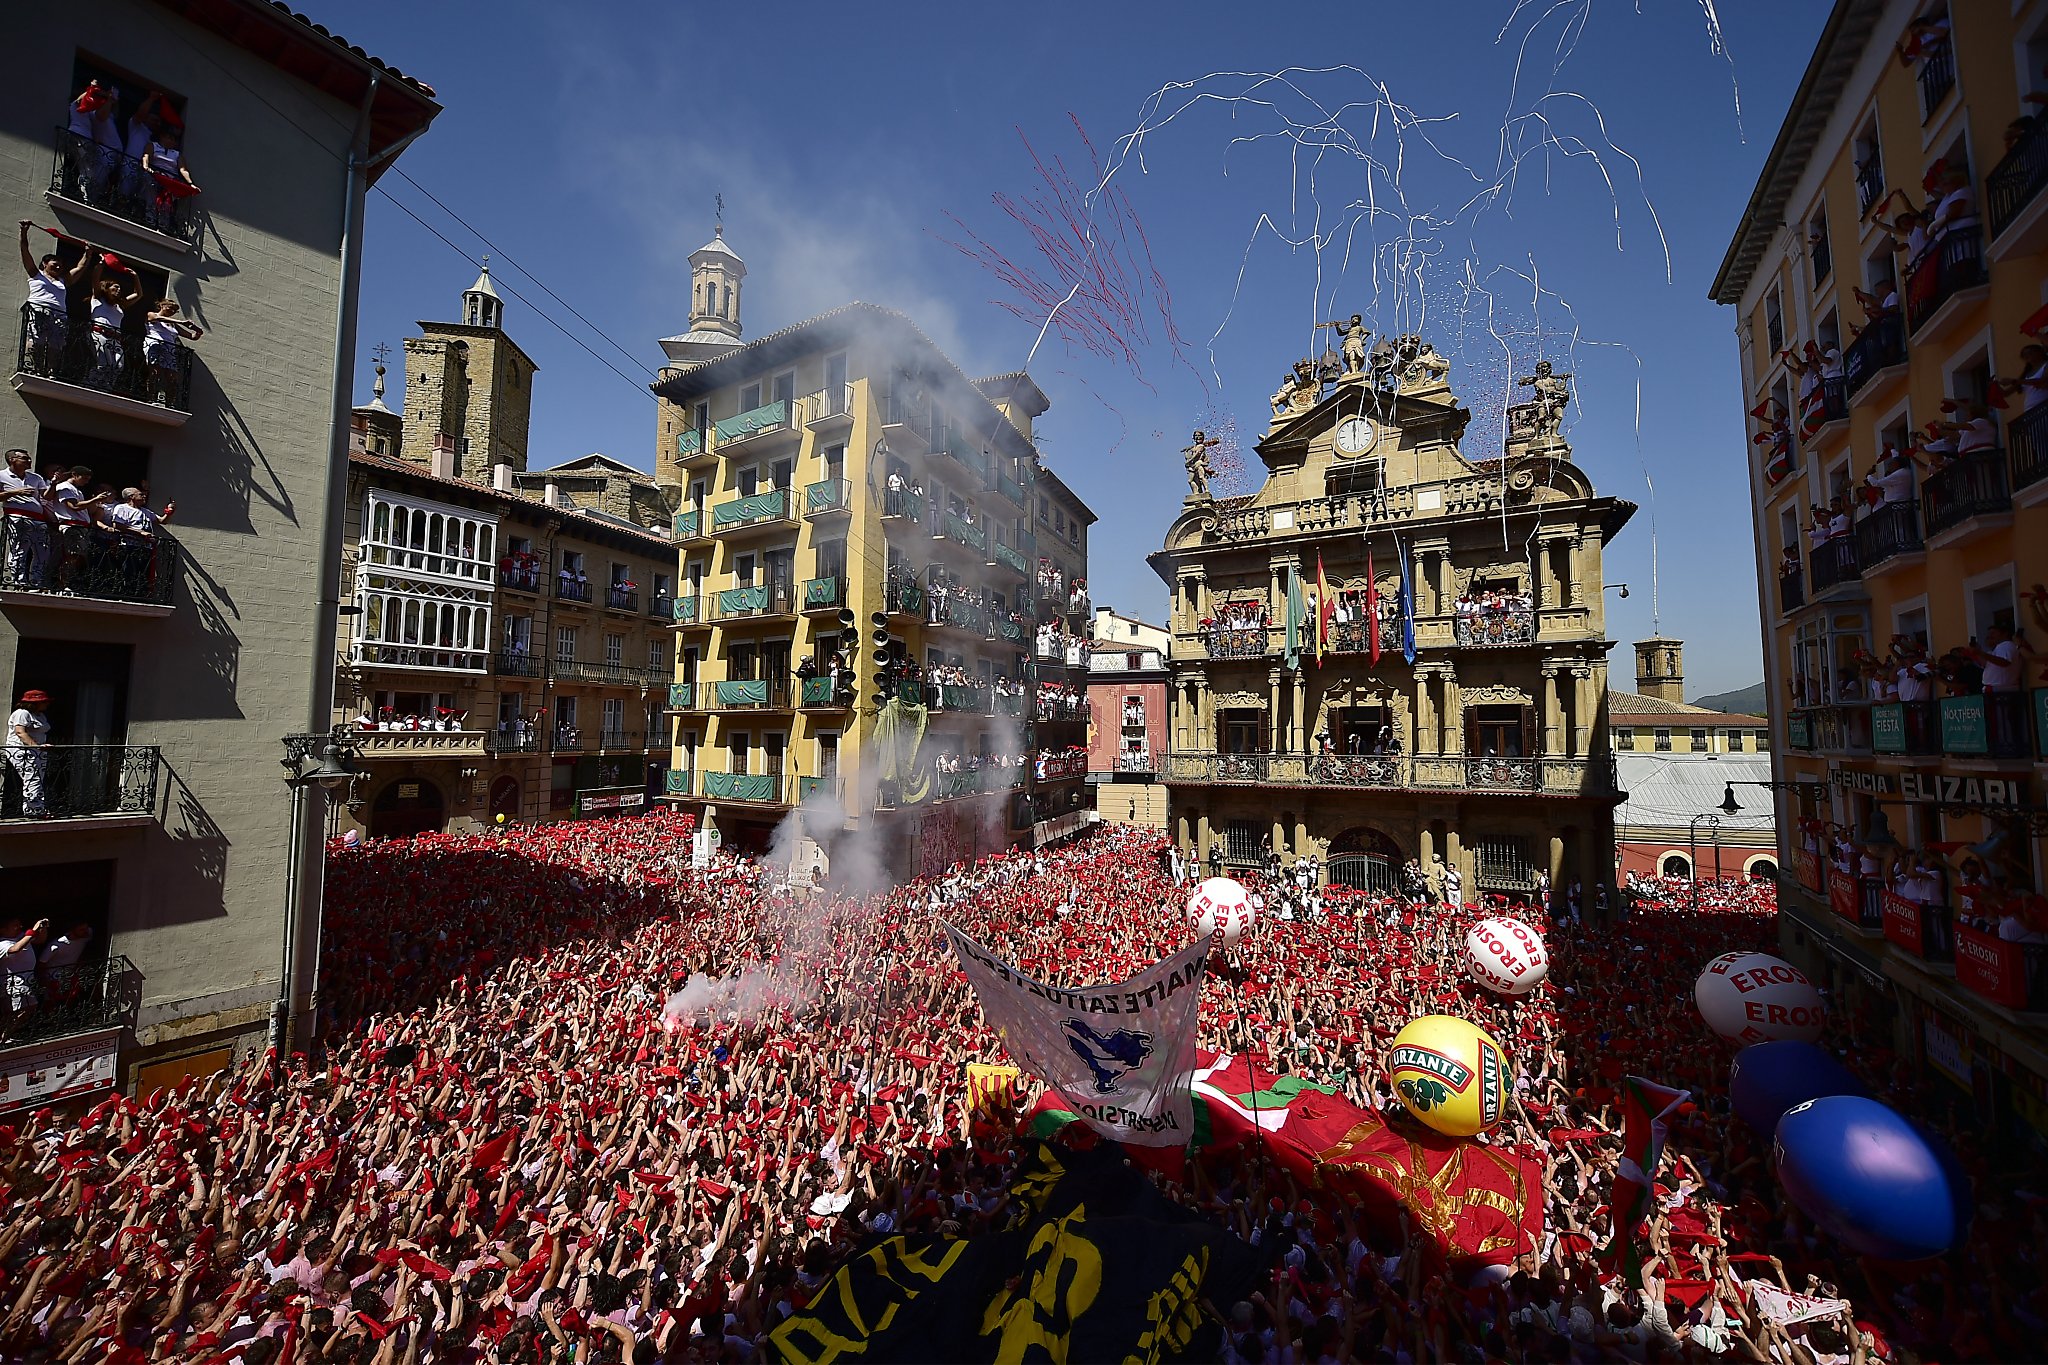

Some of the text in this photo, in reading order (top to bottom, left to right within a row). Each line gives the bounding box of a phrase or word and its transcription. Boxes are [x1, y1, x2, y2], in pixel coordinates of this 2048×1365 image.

[1875, 719, 1900, 732] FIESTA
[1826, 769, 2019, 805] AGENCIA ELIZARI
[1893, 903, 1915, 921] EROSKI
[1967, 942, 1999, 966] EROSKI
[45, 1040, 111, 1060] COLD DRINKS
[1393, 1049, 1463, 1083] URZANTE
[1485, 1048, 1497, 1122] URZANTE
